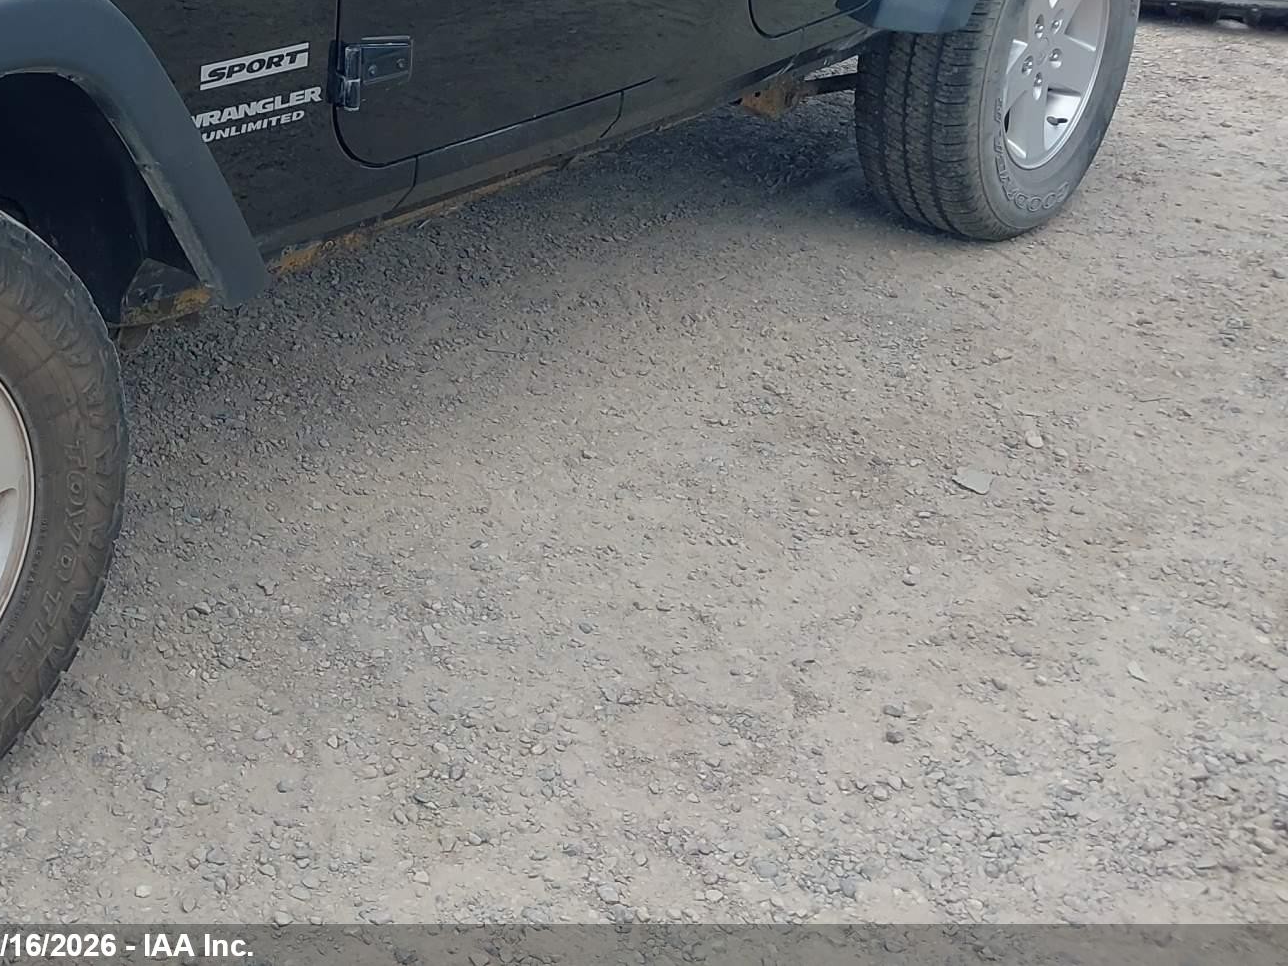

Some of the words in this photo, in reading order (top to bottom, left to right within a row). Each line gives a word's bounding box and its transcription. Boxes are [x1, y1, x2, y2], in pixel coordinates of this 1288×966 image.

[206, 49, 308, 82] SPORT
[202, 111, 305, 143] UNLIMITED
[52, 437, 87, 583] TOYO
